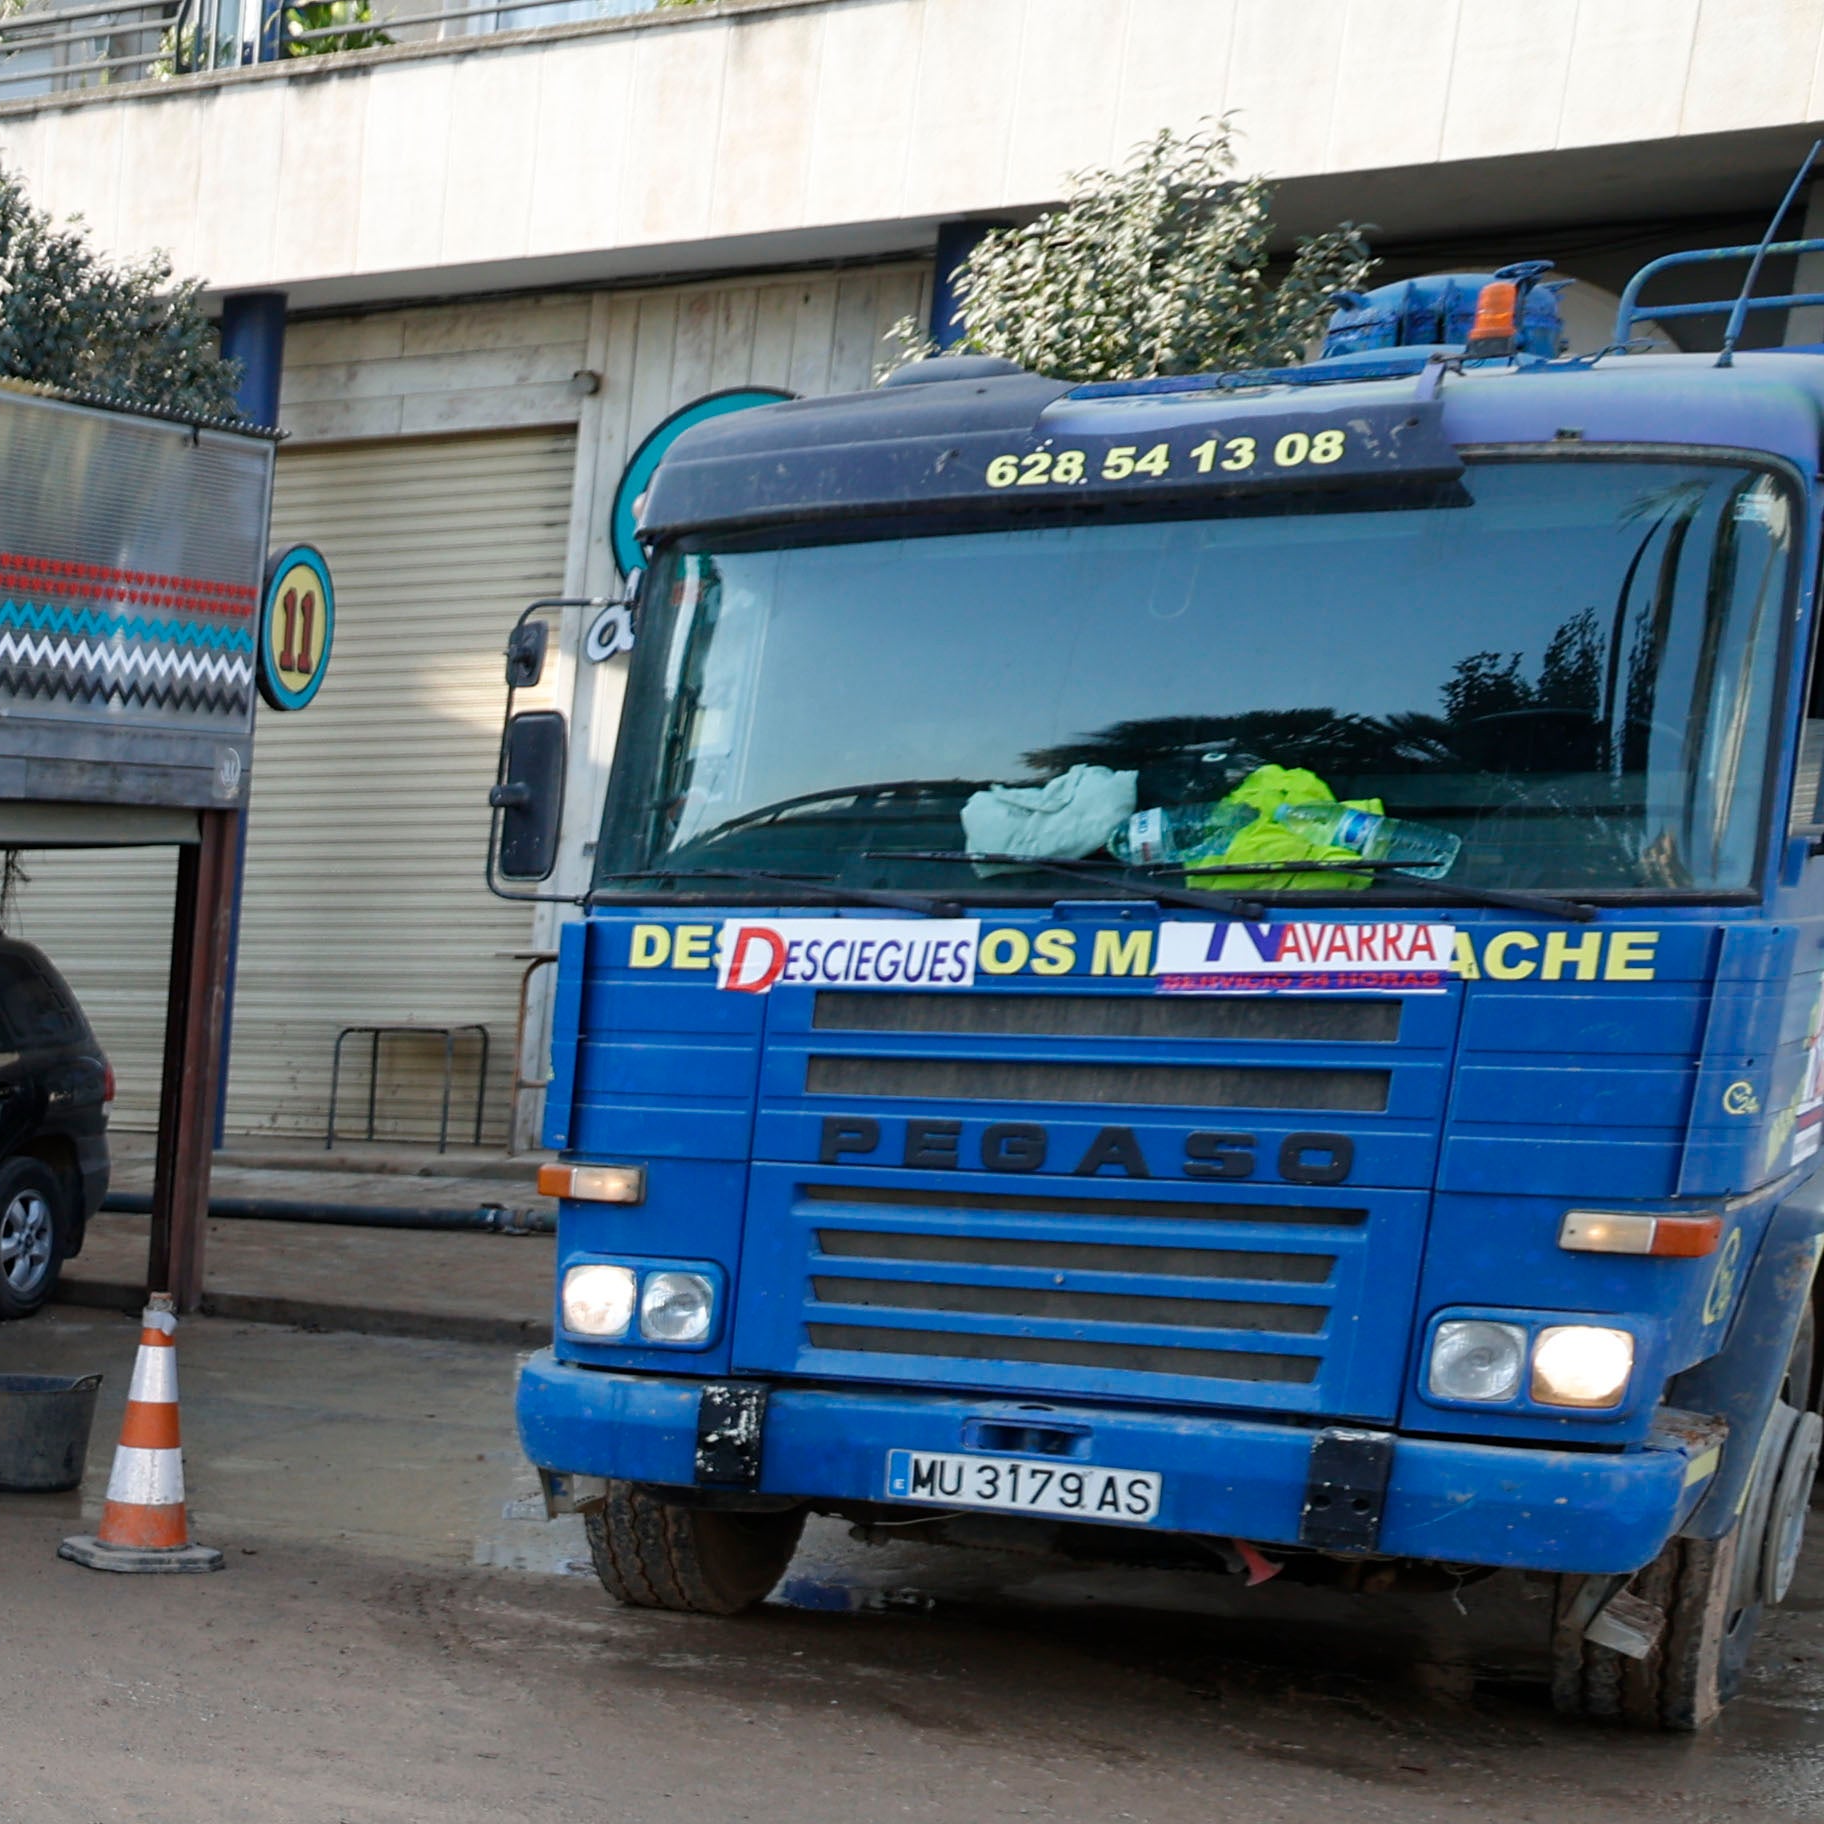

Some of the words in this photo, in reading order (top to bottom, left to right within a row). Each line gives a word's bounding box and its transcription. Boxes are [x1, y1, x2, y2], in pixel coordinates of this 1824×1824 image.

[985, 450, 1086, 488] 628
[1101, 443, 1170, 480] 54
[1190, 437, 1256, 473] 13
[1273, 429, 1346, 467] 08
[281, 588, 315, 673] 11
[722, 926, 972, 993] DESCIEGUES
[1204, 921, 1438, 963] NAVARRA
[1162, 973, 1293, 989] SERVICIO
[1298, 972, 1330, 988] 24
[1336, 971, 1441, 986] HORAS
[818, 1115, 1355, 1186] PEGASO
[911, 1458, 964, 1497] MU
[976, 1463, 1085, 1509] 3179
[1096, 1475, 1154, 1516] AS
